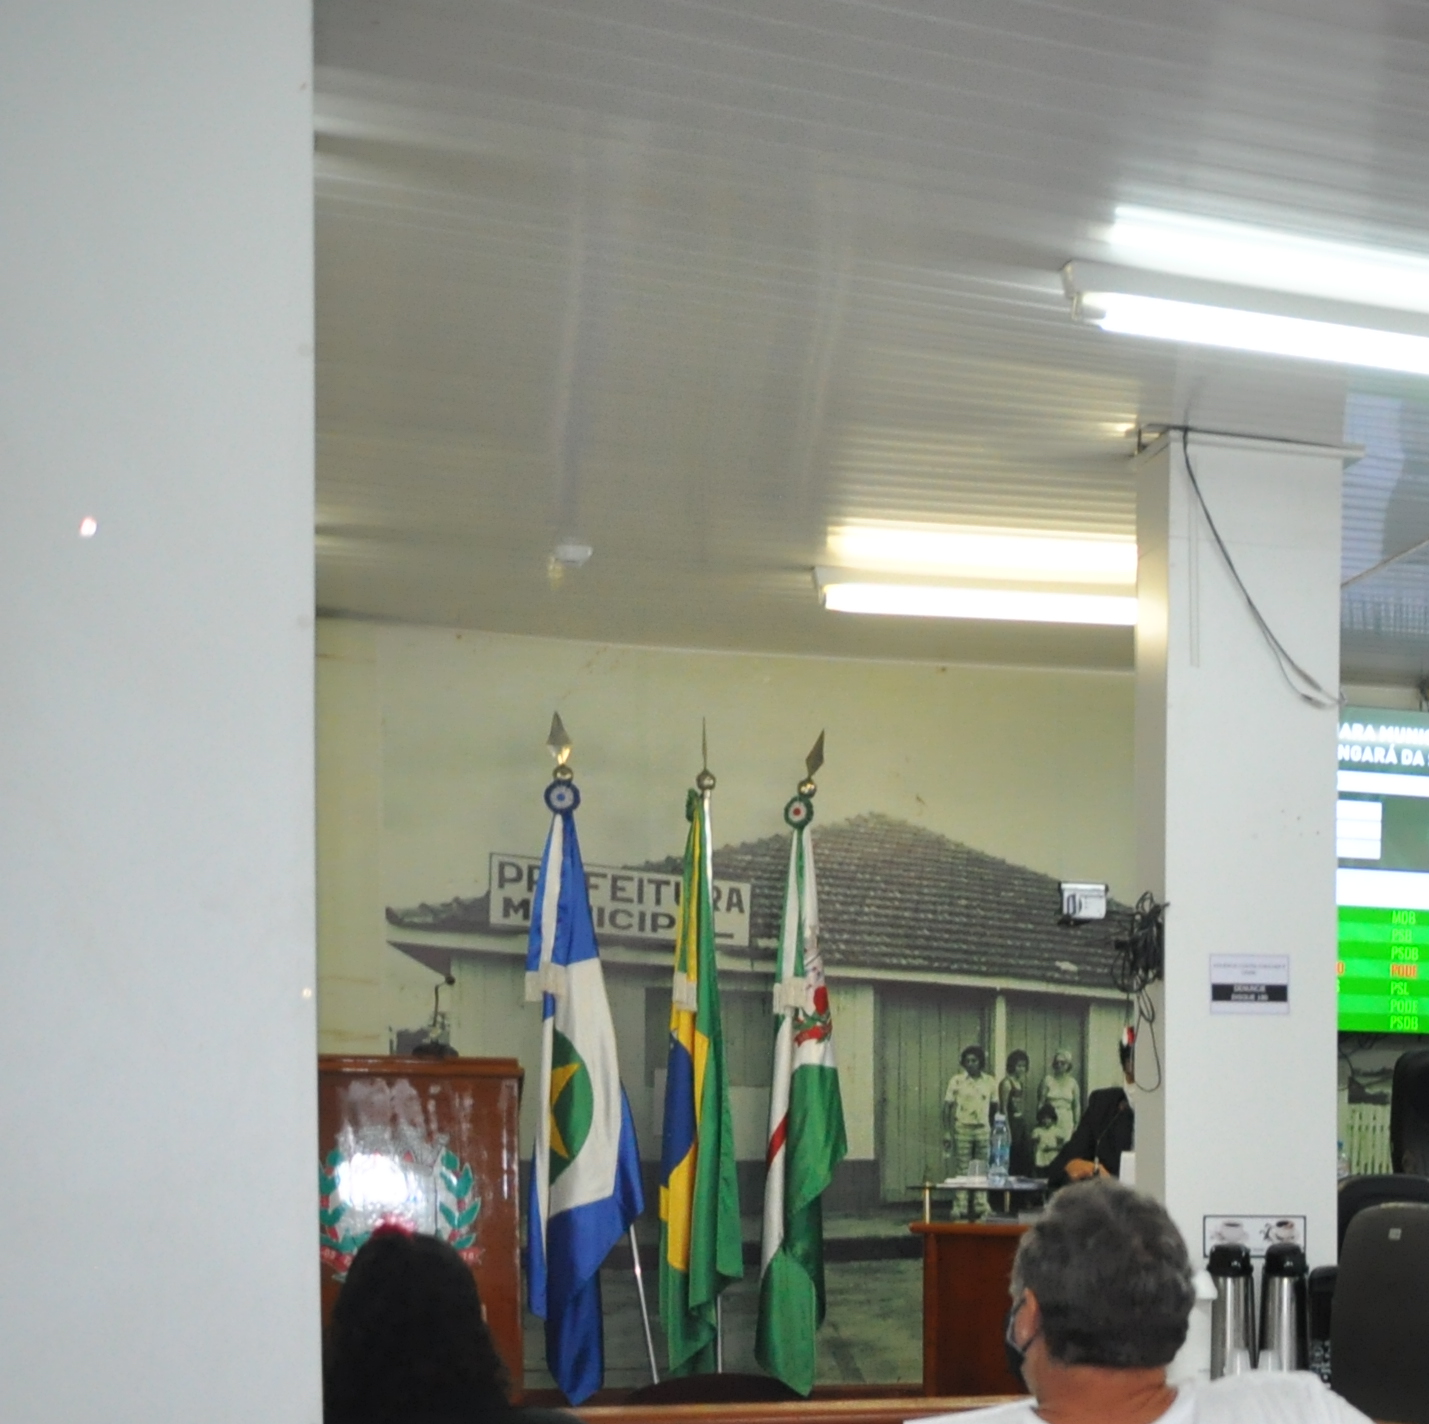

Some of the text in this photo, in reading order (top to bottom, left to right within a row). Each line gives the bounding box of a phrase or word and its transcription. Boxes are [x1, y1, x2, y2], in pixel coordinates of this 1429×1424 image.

[1337, 743, 1398, 765] NGARÁ
[1401, 748, 1425, 767] DA
[1391, 910, 1417, 926] MDB
[1391, 928, 1413, 944] PSB
[1391, 946, 1419, 961] PSDB
[1390, 981, 1410, 996] PSL
[1390, 999, 1419, 1014] PODE
[1389, 1015, 1420, 1031] PSDB
